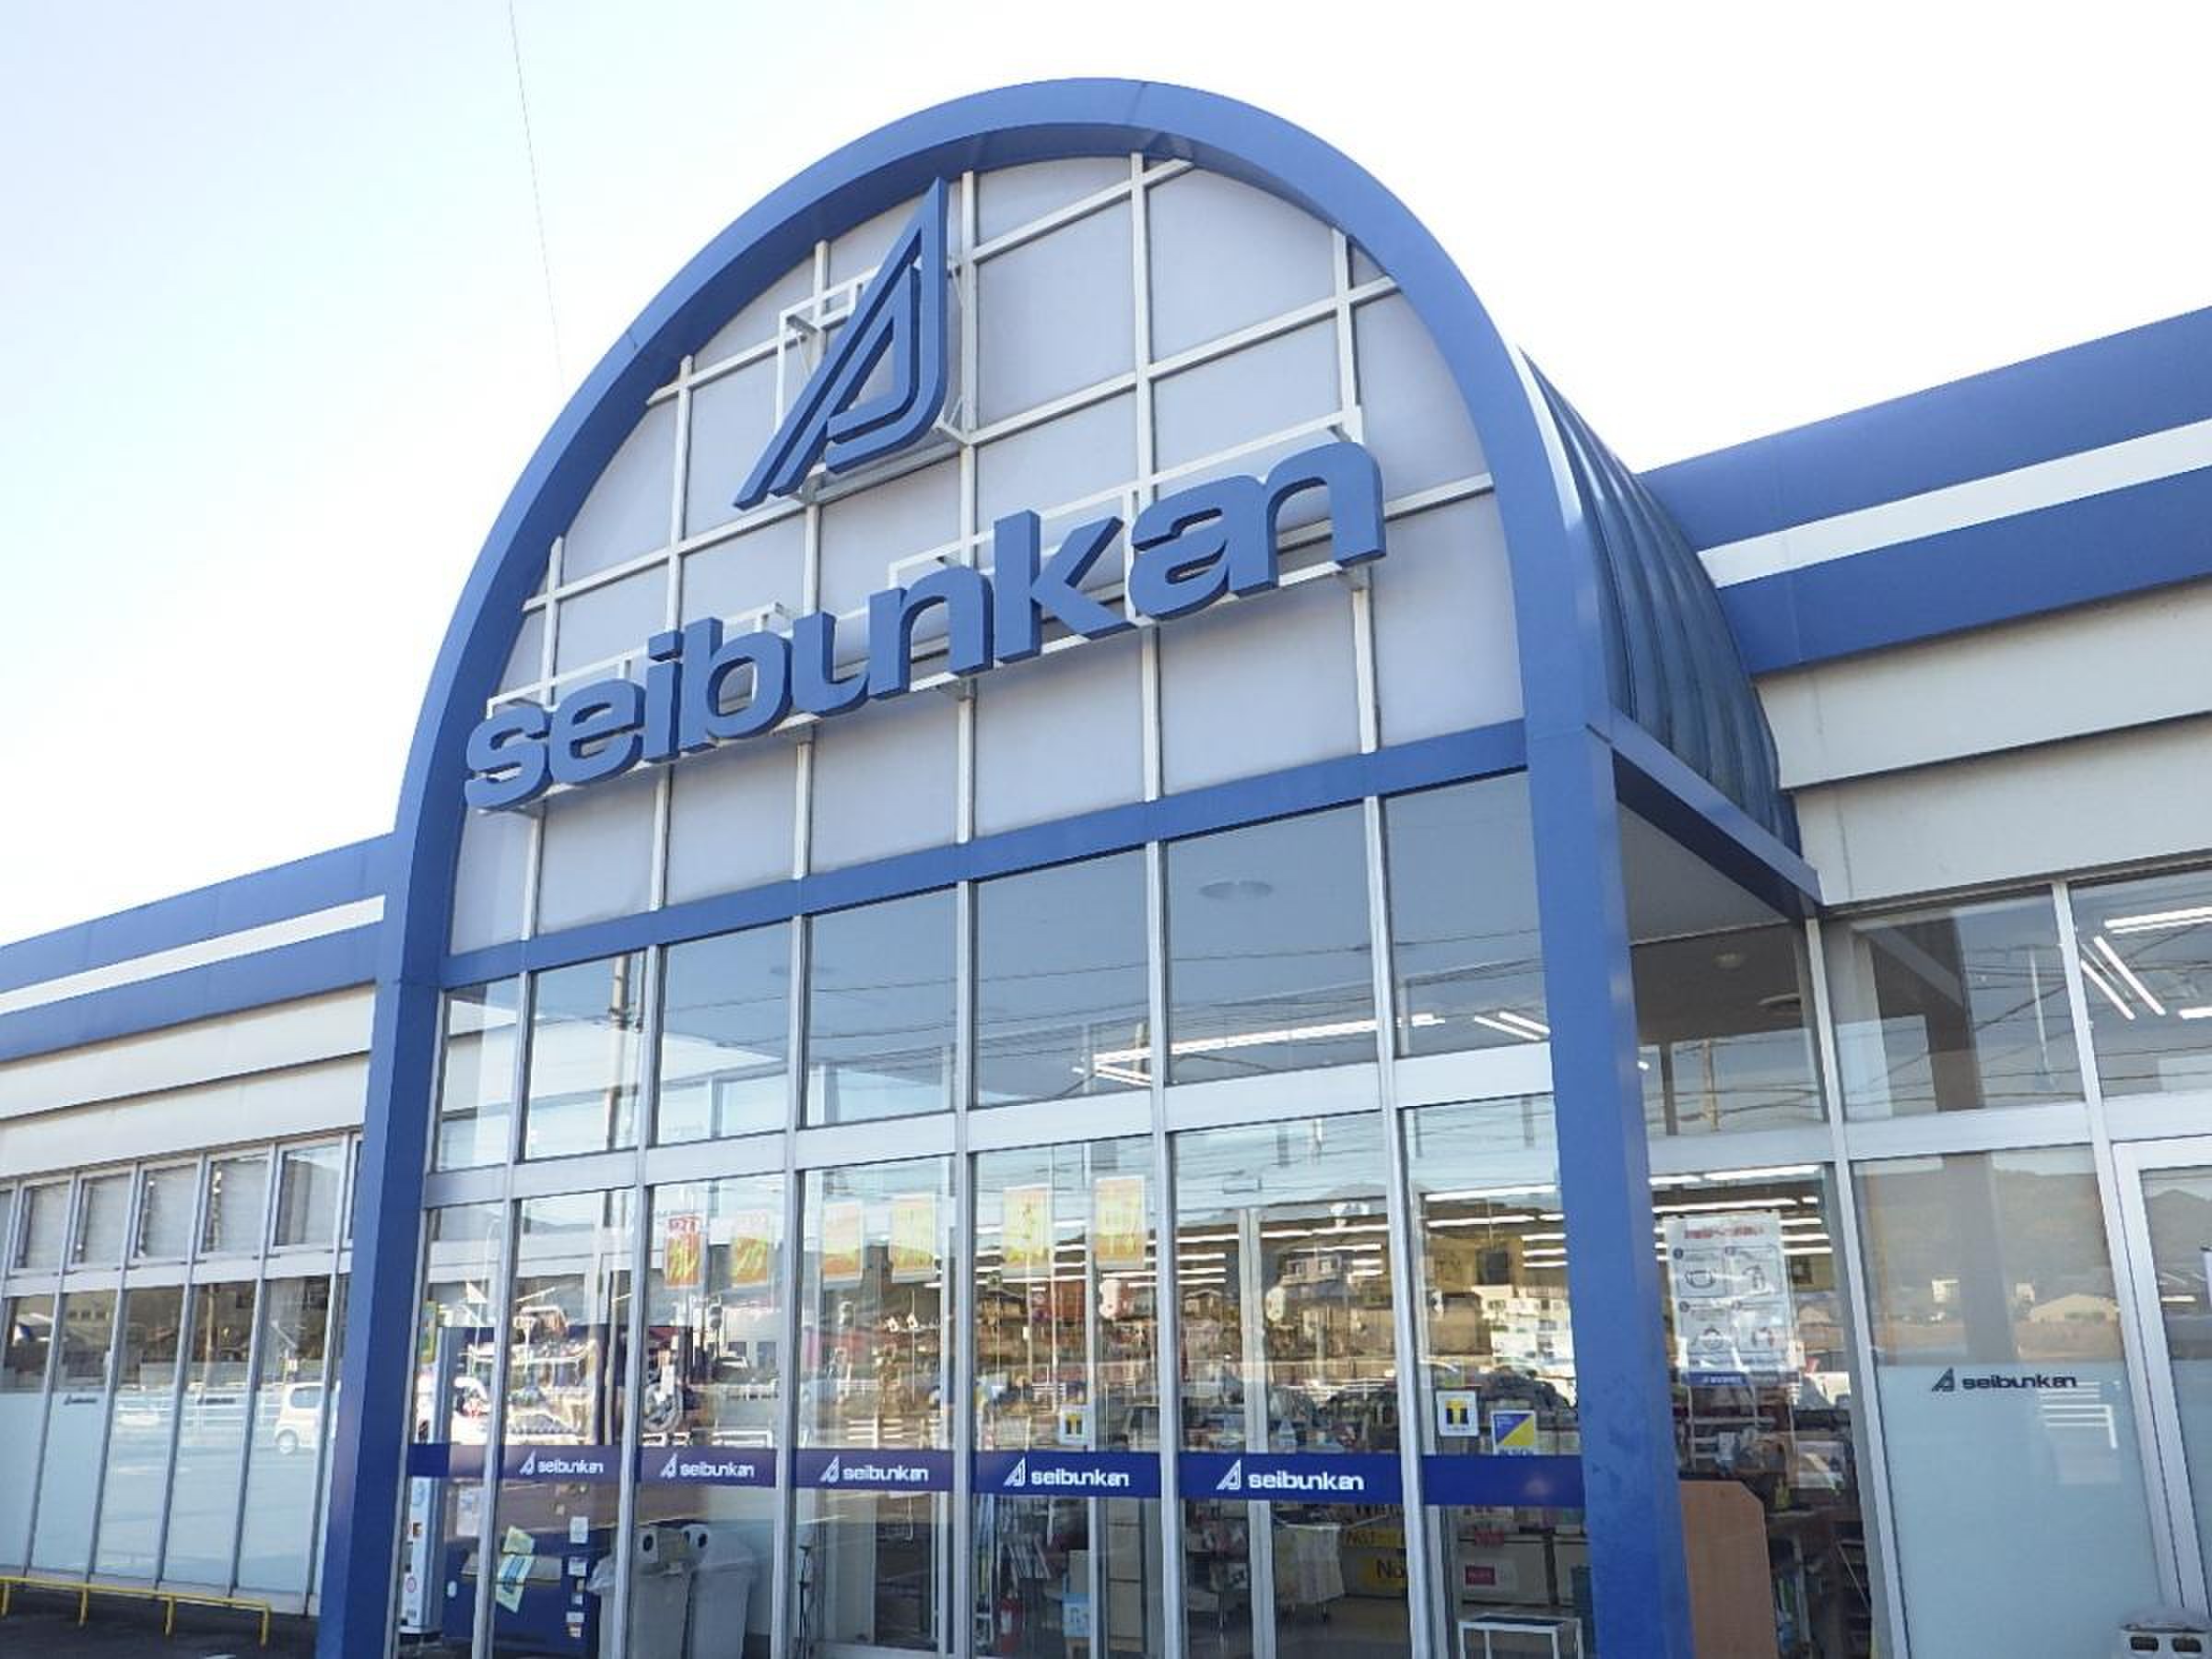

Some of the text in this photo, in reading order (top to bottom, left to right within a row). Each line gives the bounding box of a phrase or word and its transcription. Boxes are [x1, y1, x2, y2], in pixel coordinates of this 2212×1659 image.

[465, 441, 1387, 812] seibunkan
[1960, 1373, 2077, 1390] seibunkan
[537, 1458, 604, 1475] seibunkan
[679, 1461, 755, 1478] seibunkan
[842, 1464, 929, 1483] seibunkan
[1030, 1466, 1130, 1488] seibunkan
[1248, 1469, 1366, 1490] seibunkan
